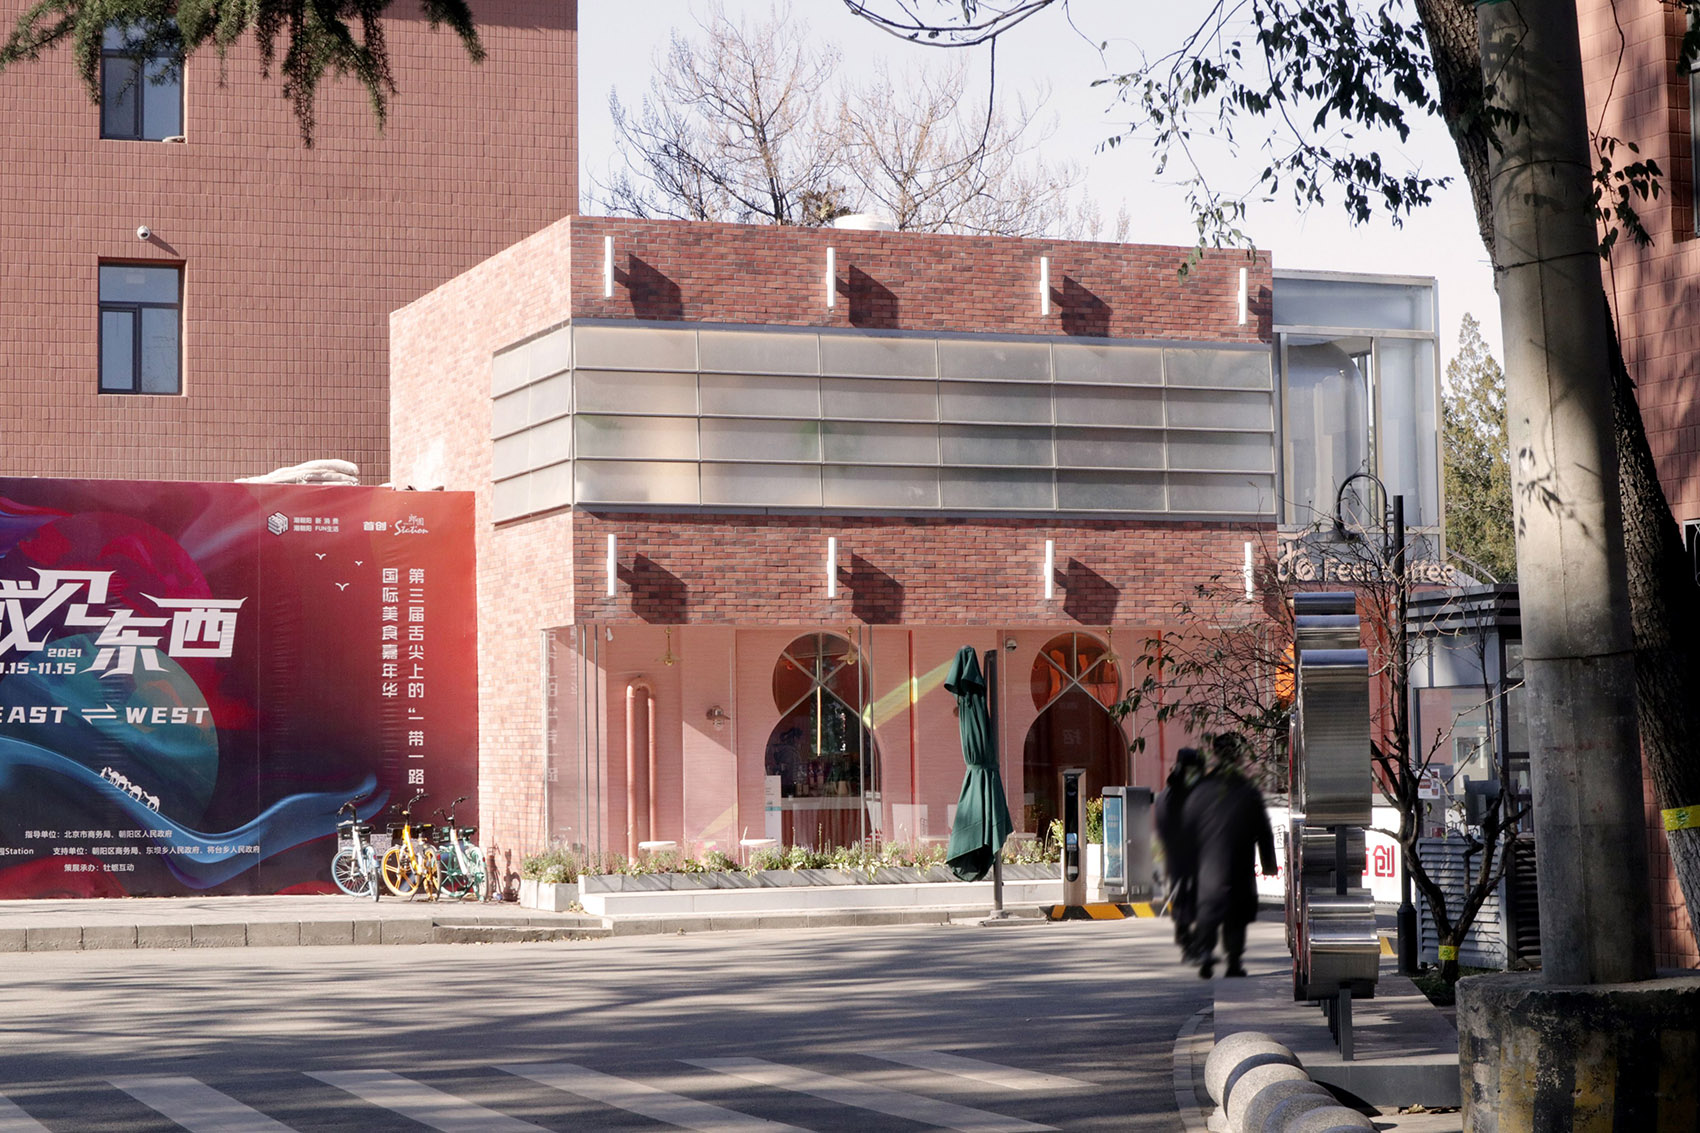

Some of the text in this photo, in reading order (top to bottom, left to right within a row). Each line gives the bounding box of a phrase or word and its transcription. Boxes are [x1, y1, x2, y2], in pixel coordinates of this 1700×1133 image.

[382, 568, 399, 698] 国际美食嘉年华
[47, 648, 82, 658] 2021
[125, 706, 210, 724] WEST
